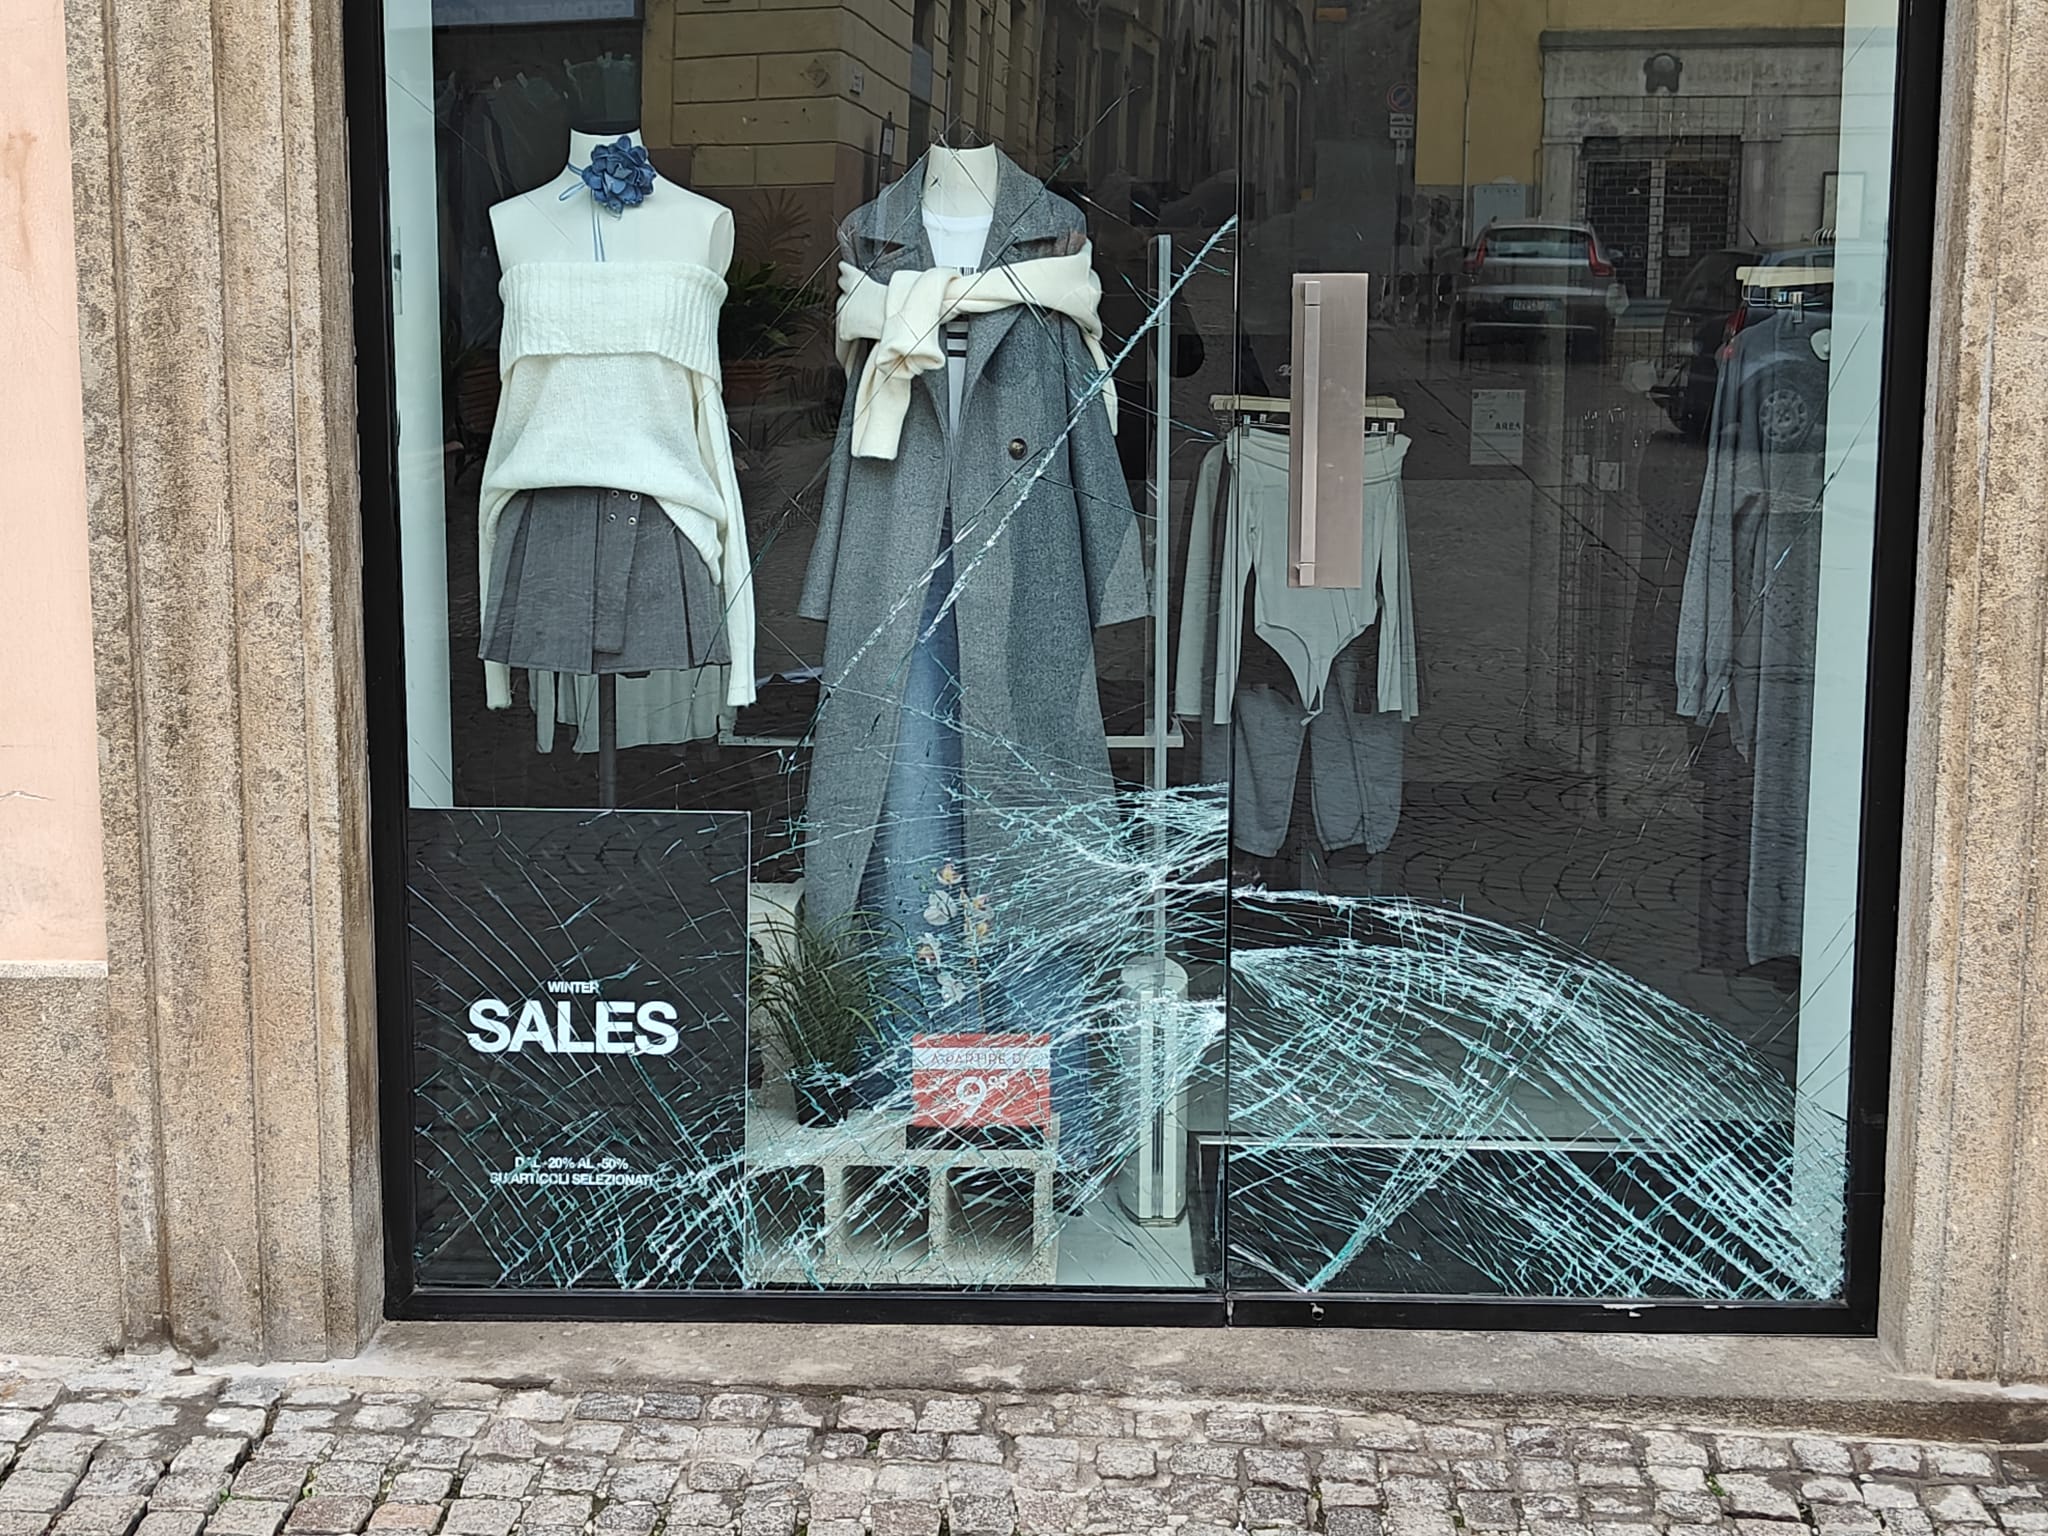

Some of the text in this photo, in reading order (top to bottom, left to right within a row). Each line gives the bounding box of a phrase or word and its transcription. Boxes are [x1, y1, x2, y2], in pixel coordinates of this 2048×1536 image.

[547, 980, 600, 994] WINTER
[467, 999, 680, 1056] SALES
[577, 1157, 595, 1169] AL
[597, 1157, 629, 1170] -50%
[490, 1172, 509, 1185] SU
[510, 1172, 570, 1186] ARTICOLI
